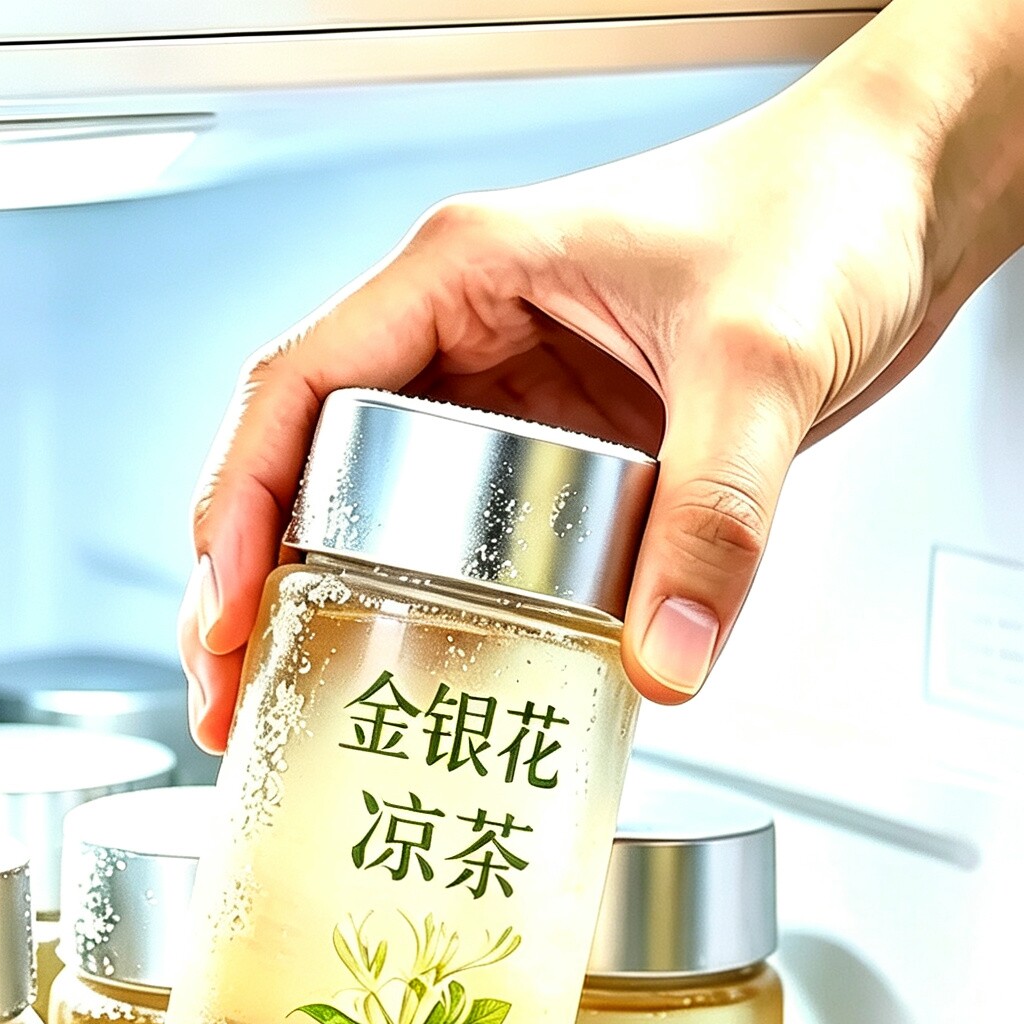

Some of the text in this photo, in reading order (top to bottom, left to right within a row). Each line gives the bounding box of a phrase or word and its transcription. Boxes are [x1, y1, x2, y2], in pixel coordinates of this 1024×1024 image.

[339, 670, 570, 790] 金银花
[350, 789, 534, 900] 凉茶
